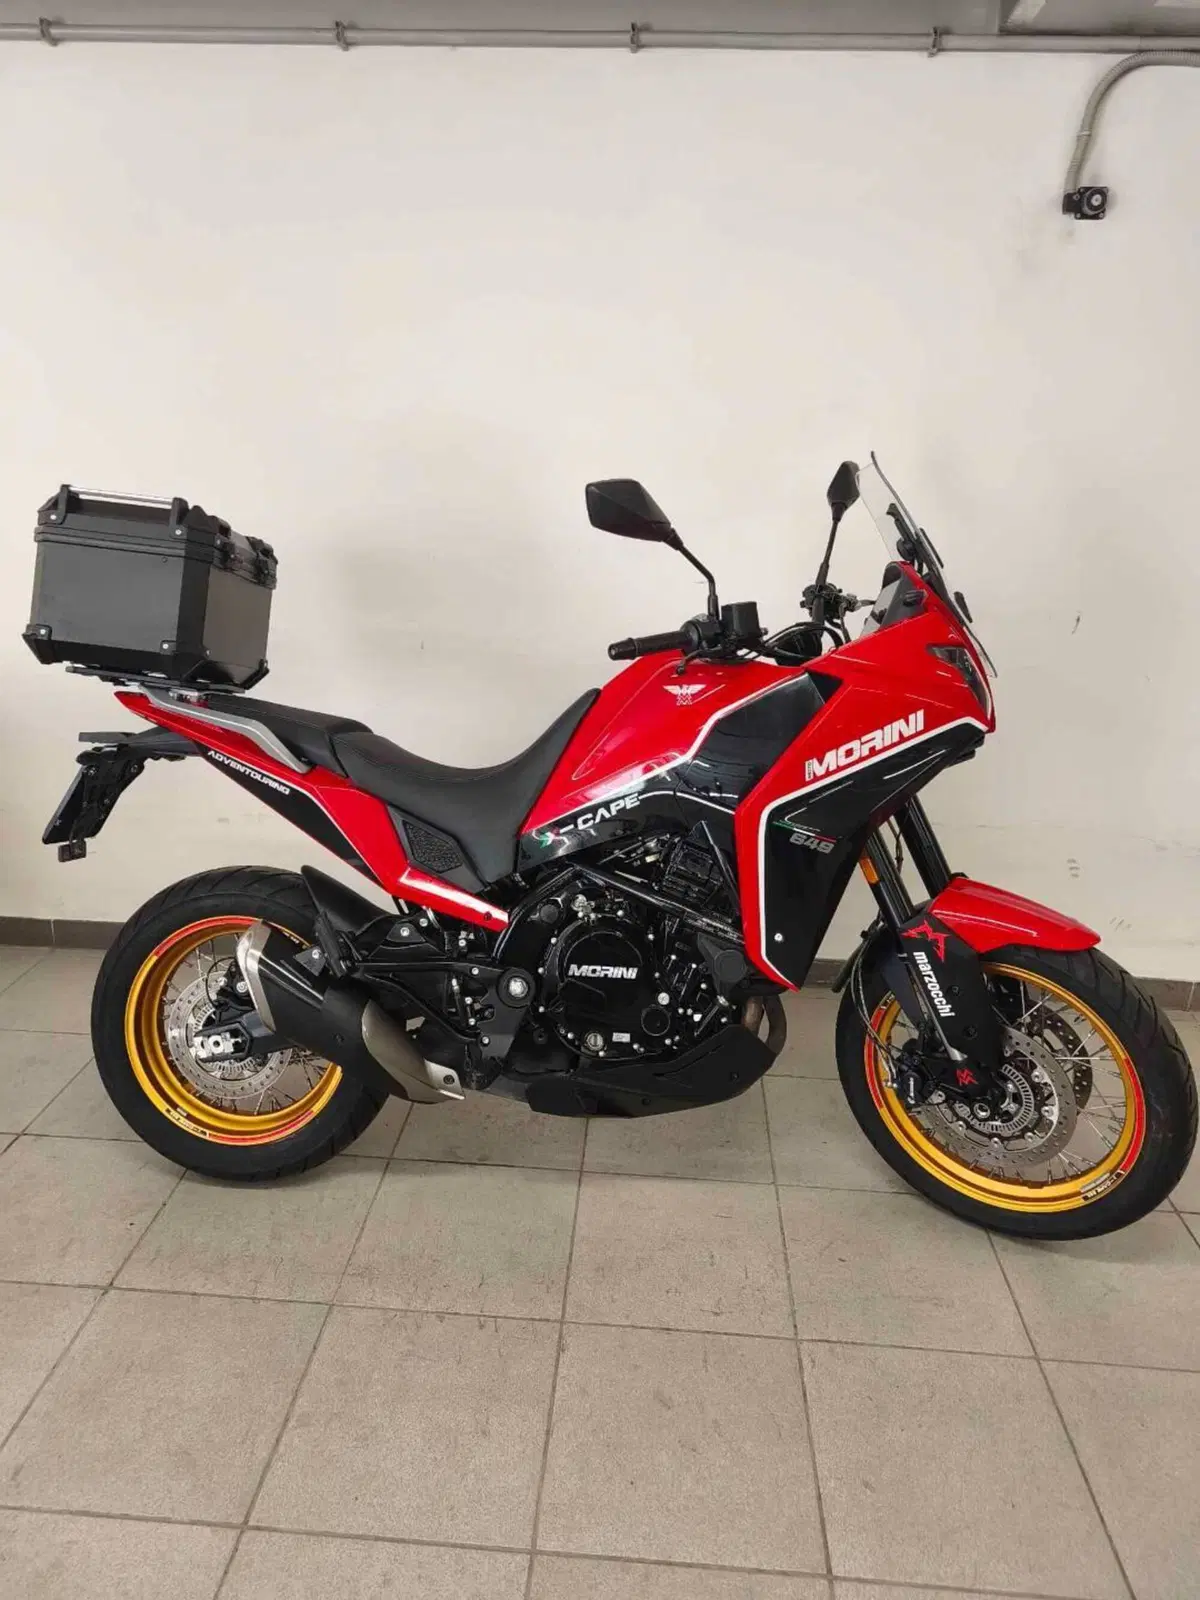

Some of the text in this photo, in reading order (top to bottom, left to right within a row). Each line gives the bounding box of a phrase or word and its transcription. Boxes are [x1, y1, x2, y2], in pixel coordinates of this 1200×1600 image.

[812, 708, 925, 777] MORINI
[207, 750, 291, 795] ADVENTOURING
[789, 832, 835, 854] 649
[568, 964, 639, 979] MORINI
[912, 951, 956, 1018] marzocchi
